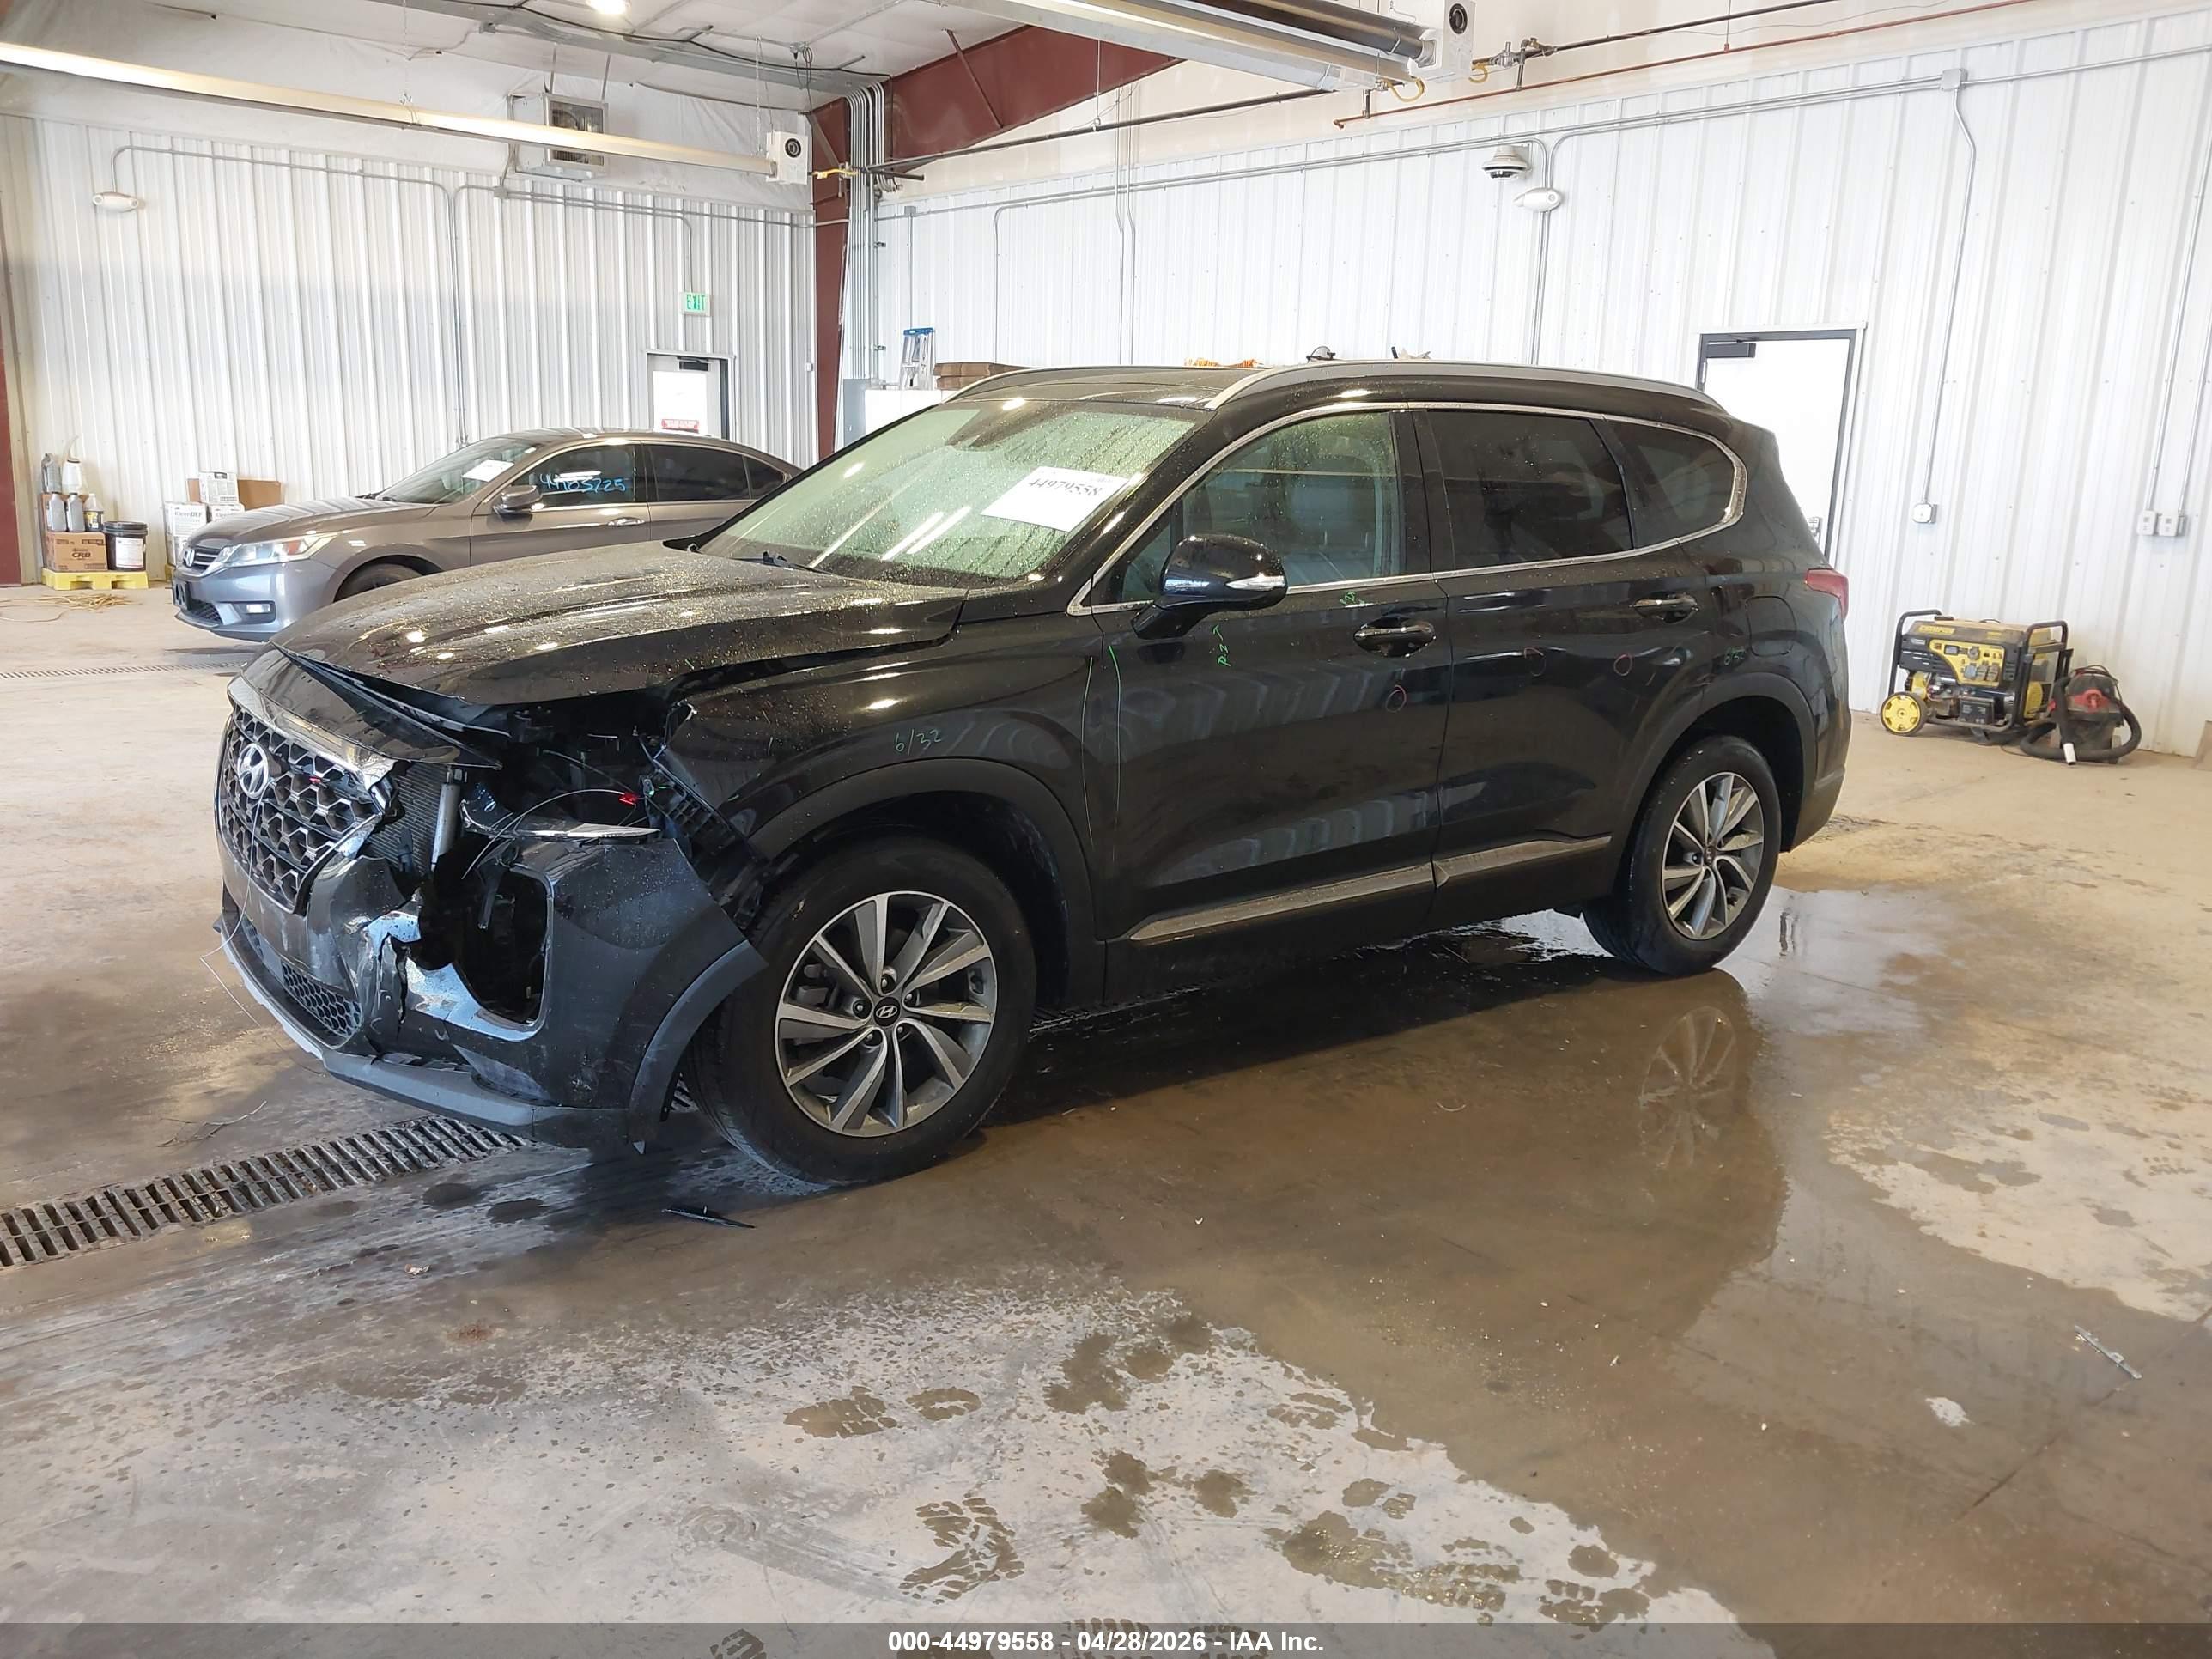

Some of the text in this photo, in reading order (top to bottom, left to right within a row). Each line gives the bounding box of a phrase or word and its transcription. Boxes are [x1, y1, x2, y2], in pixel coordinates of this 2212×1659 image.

[686, 294, 706, 311] EXIT
[1029, 478, 1103, 496] 44979558
[895, 728, 942, 756] 6/32
